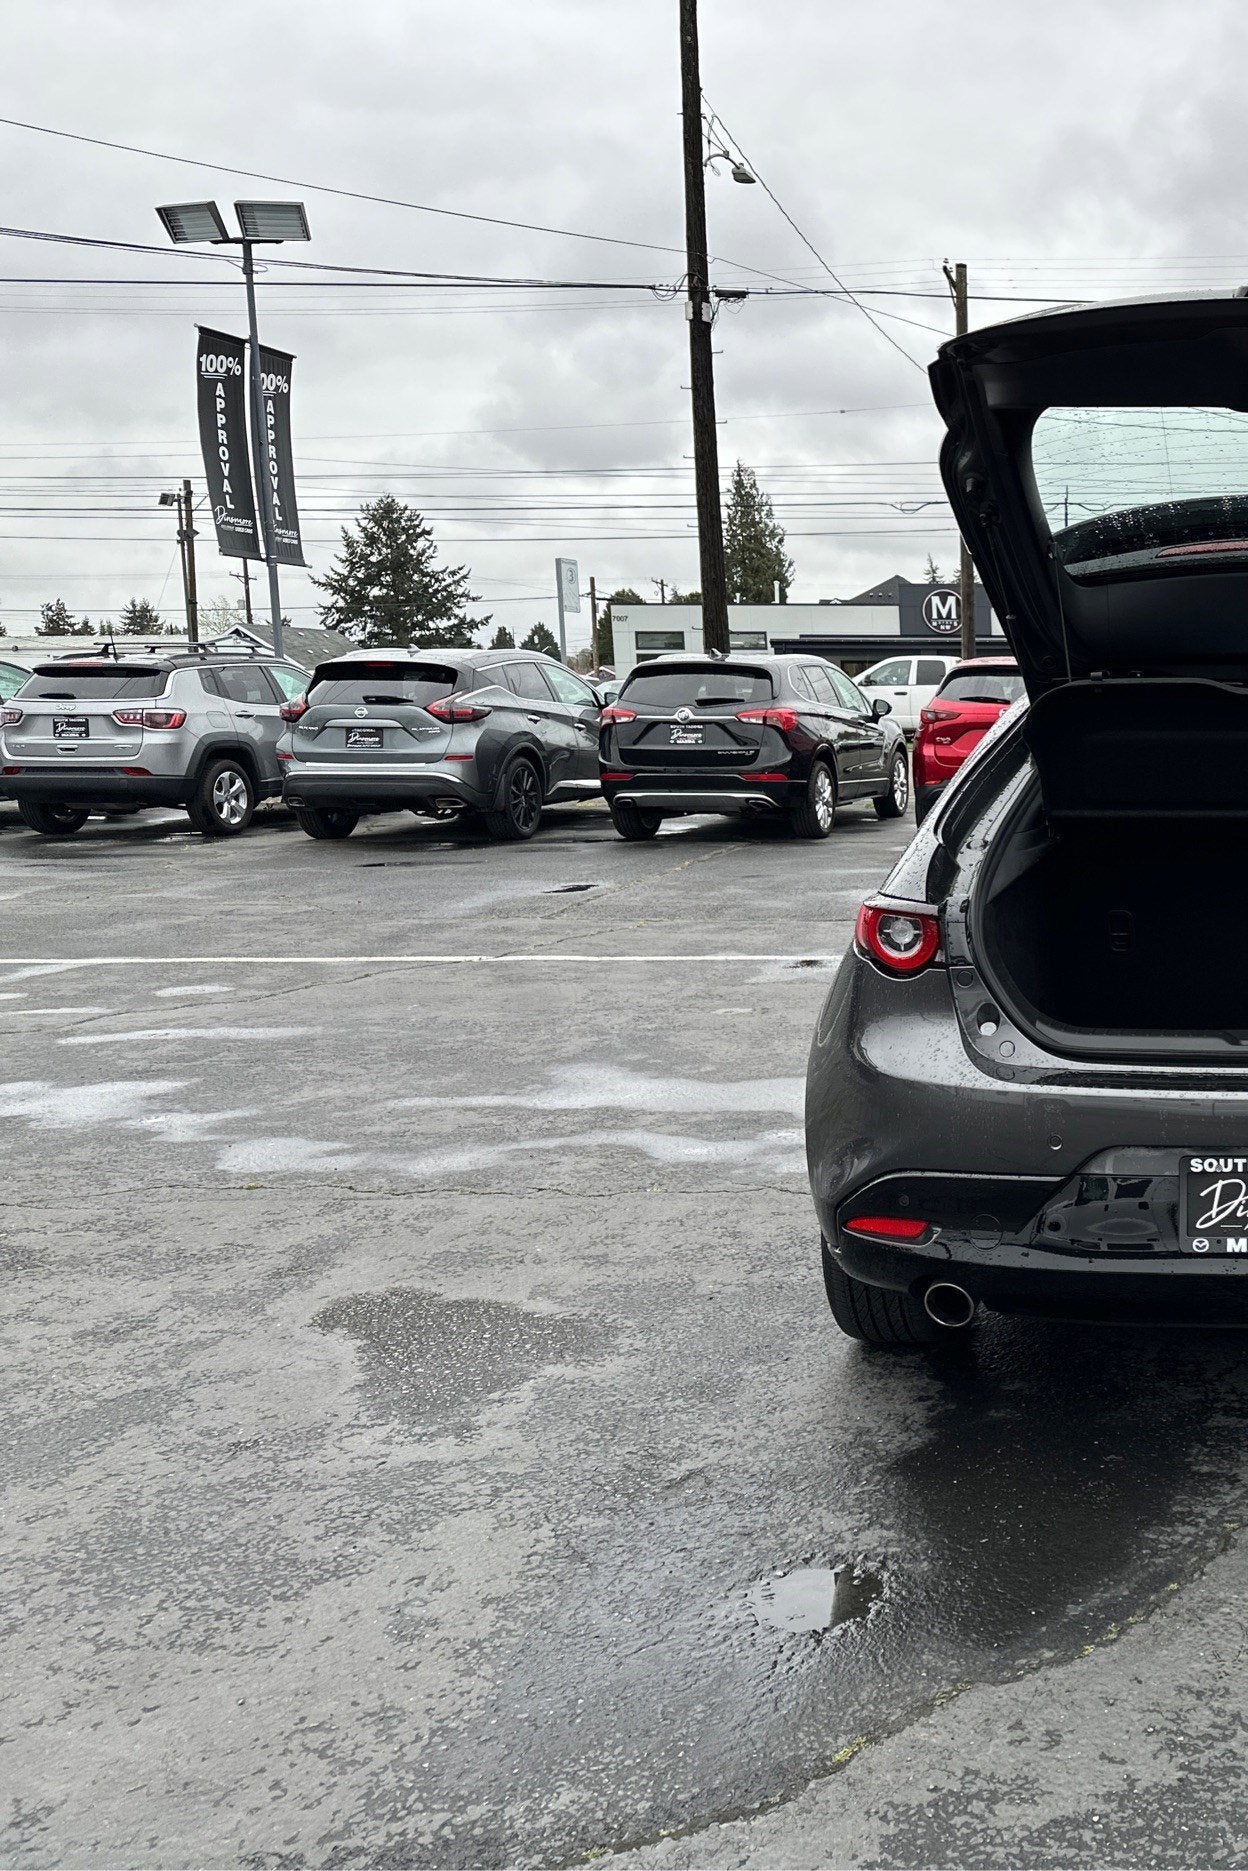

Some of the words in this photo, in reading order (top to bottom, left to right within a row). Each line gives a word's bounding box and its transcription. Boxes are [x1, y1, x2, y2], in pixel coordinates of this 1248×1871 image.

[200, 354, 242, 376] 100%
[260, 373, 289, 394] 00%
[215, 382, 235, 510] APPROVAL
[266, 400, 283, 521] APPROVAL
[931, 595, 958, 619] M
